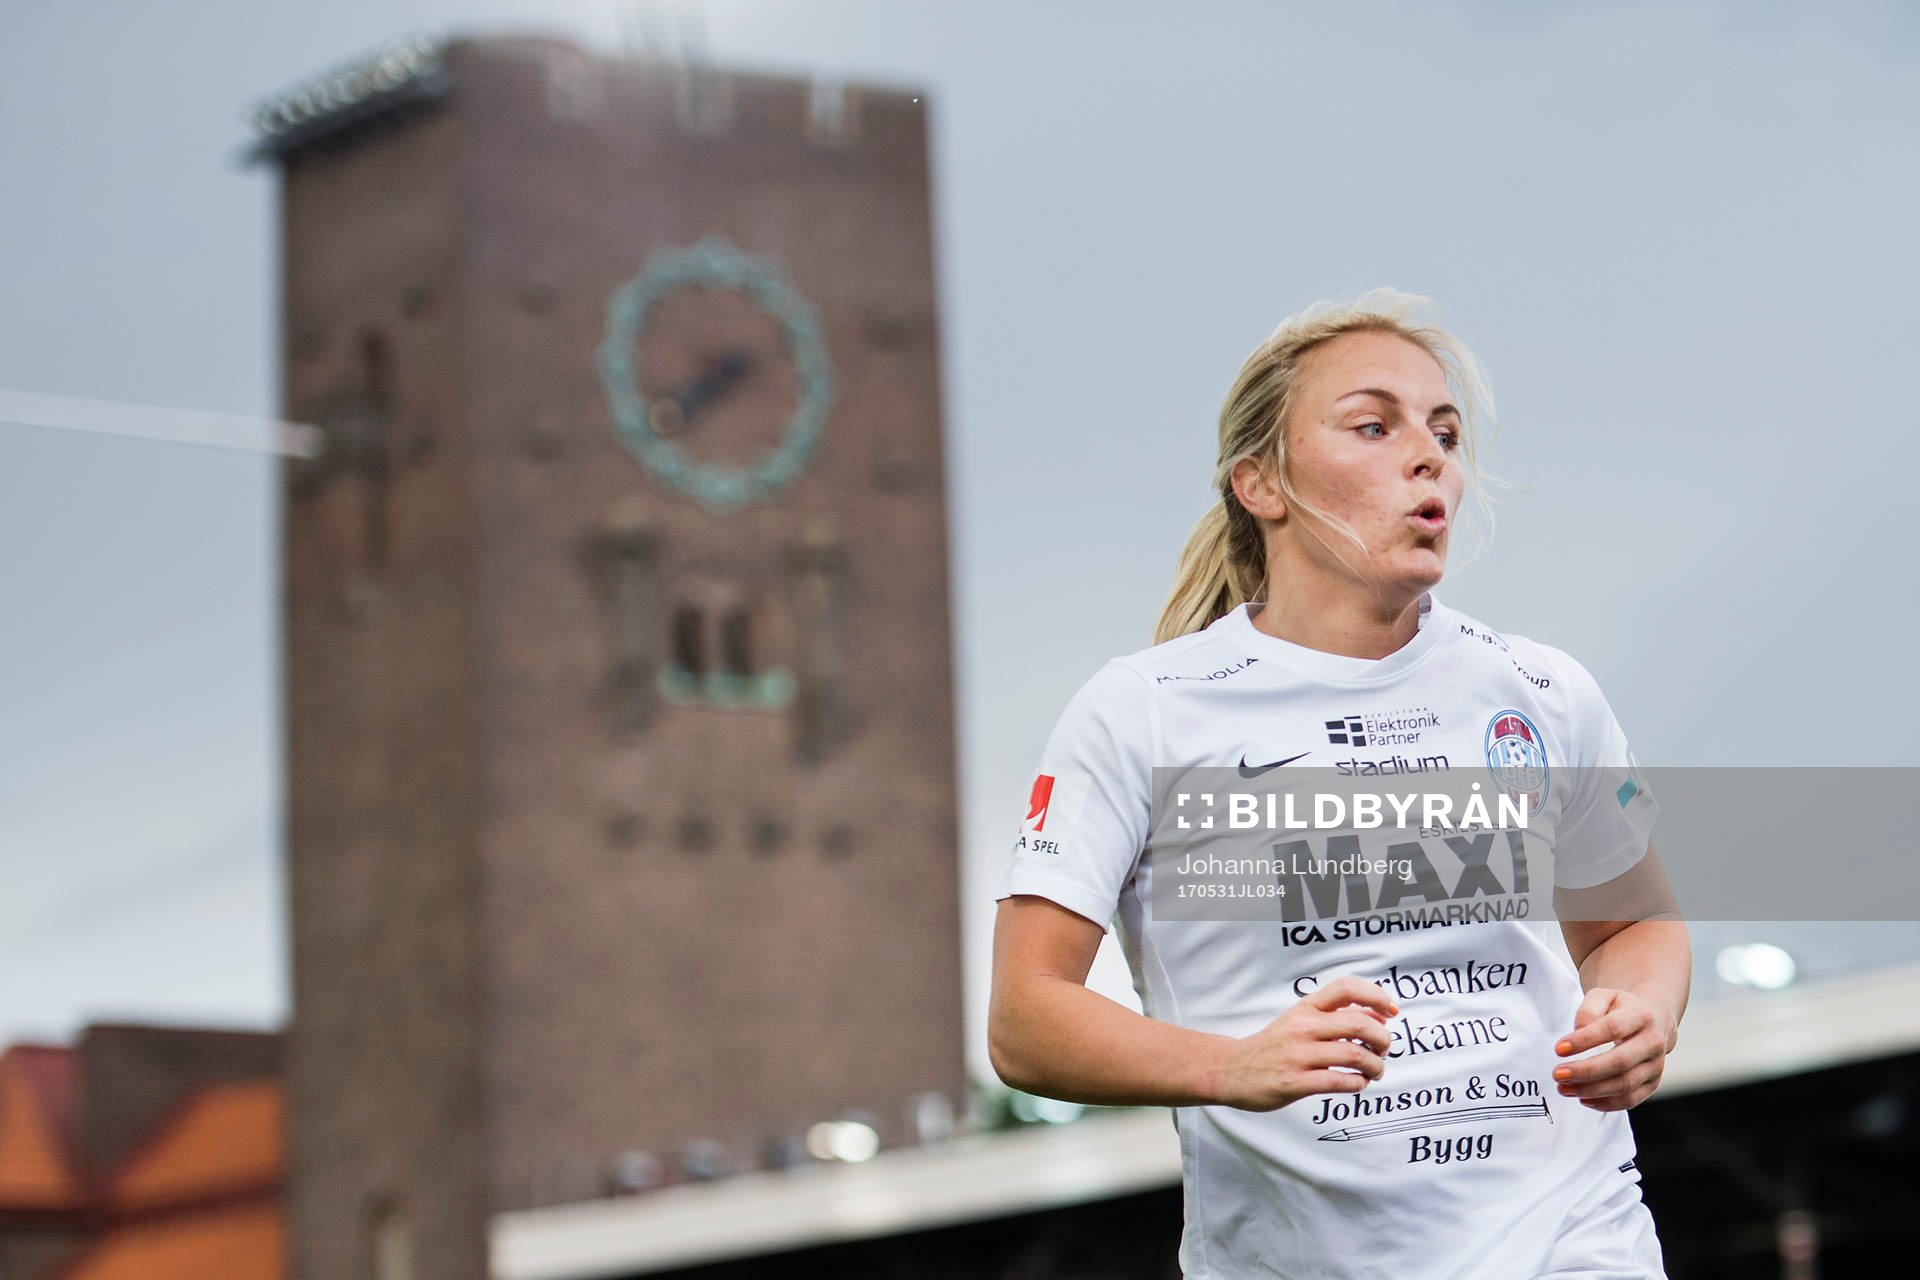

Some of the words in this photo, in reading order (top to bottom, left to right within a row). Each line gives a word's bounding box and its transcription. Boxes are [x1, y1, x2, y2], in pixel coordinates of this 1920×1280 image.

[1366, 712, 1441, 733] Elektronik
[1369, 732, 1421, 747] Partner
[1335, 755, 1450, 777] stadium
[1032, 839, 1060, 855] SPEL
[1272, 830, 1530, 923] MAXI
[1281, 925, 1328, 948] ICA
[1333, 898, 1530, 941] STORMARKNAD
[1293, 959, 1528, 1000] Srbanken
[1383, 1015, 1510, 1060] ekarne
[1312, 1086, 1453, 1125] Johnson
[1464, 1076, 1486, 1100] &
[1494, 1073, 1541, 1098] Son
[1407, 1133, 1494, 1165] Bygg
